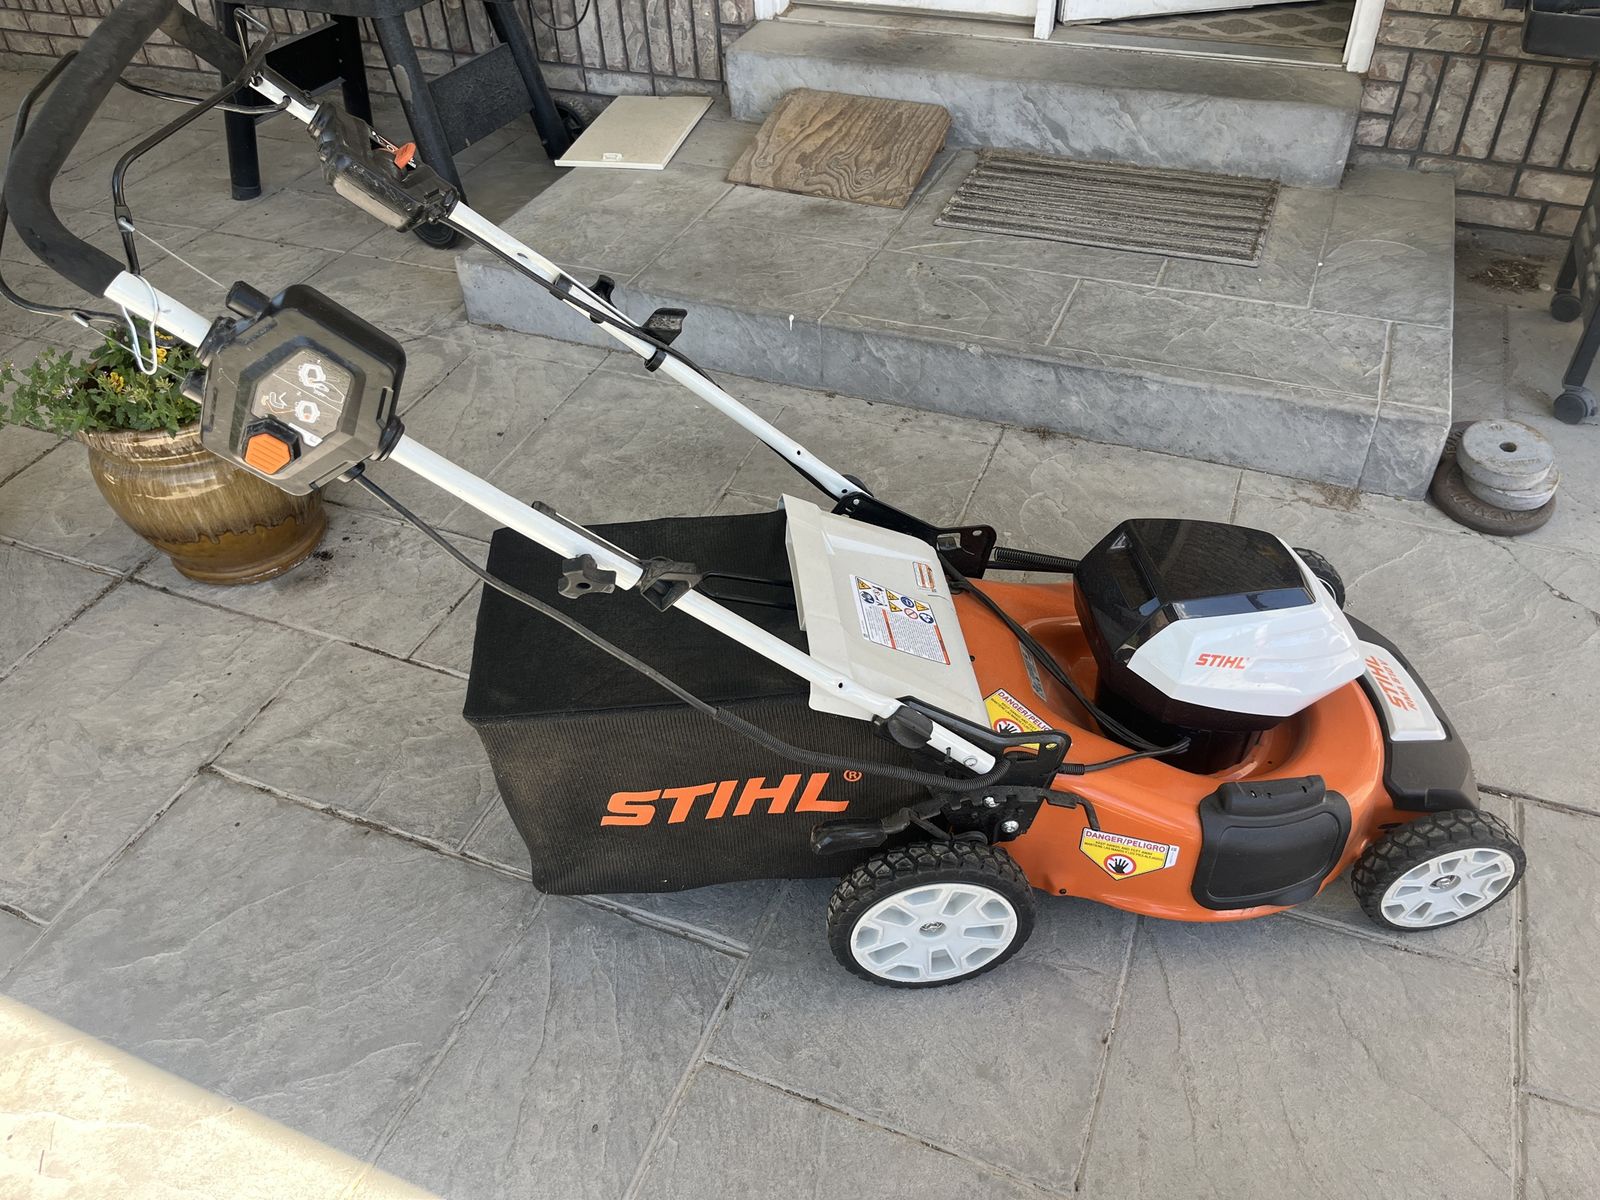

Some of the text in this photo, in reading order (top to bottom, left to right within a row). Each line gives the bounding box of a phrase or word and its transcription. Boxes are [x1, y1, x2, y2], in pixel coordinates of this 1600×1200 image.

[1195, 653, 1245, 669] STIHL
[1365, 656, 1409, 711] STIHL
[998, 691, 1051, 732] DANGER/PELI
[600, 772, 850, 826] STIHL
[1085, 830, 1166, 853] DANGER/PELIGRO
